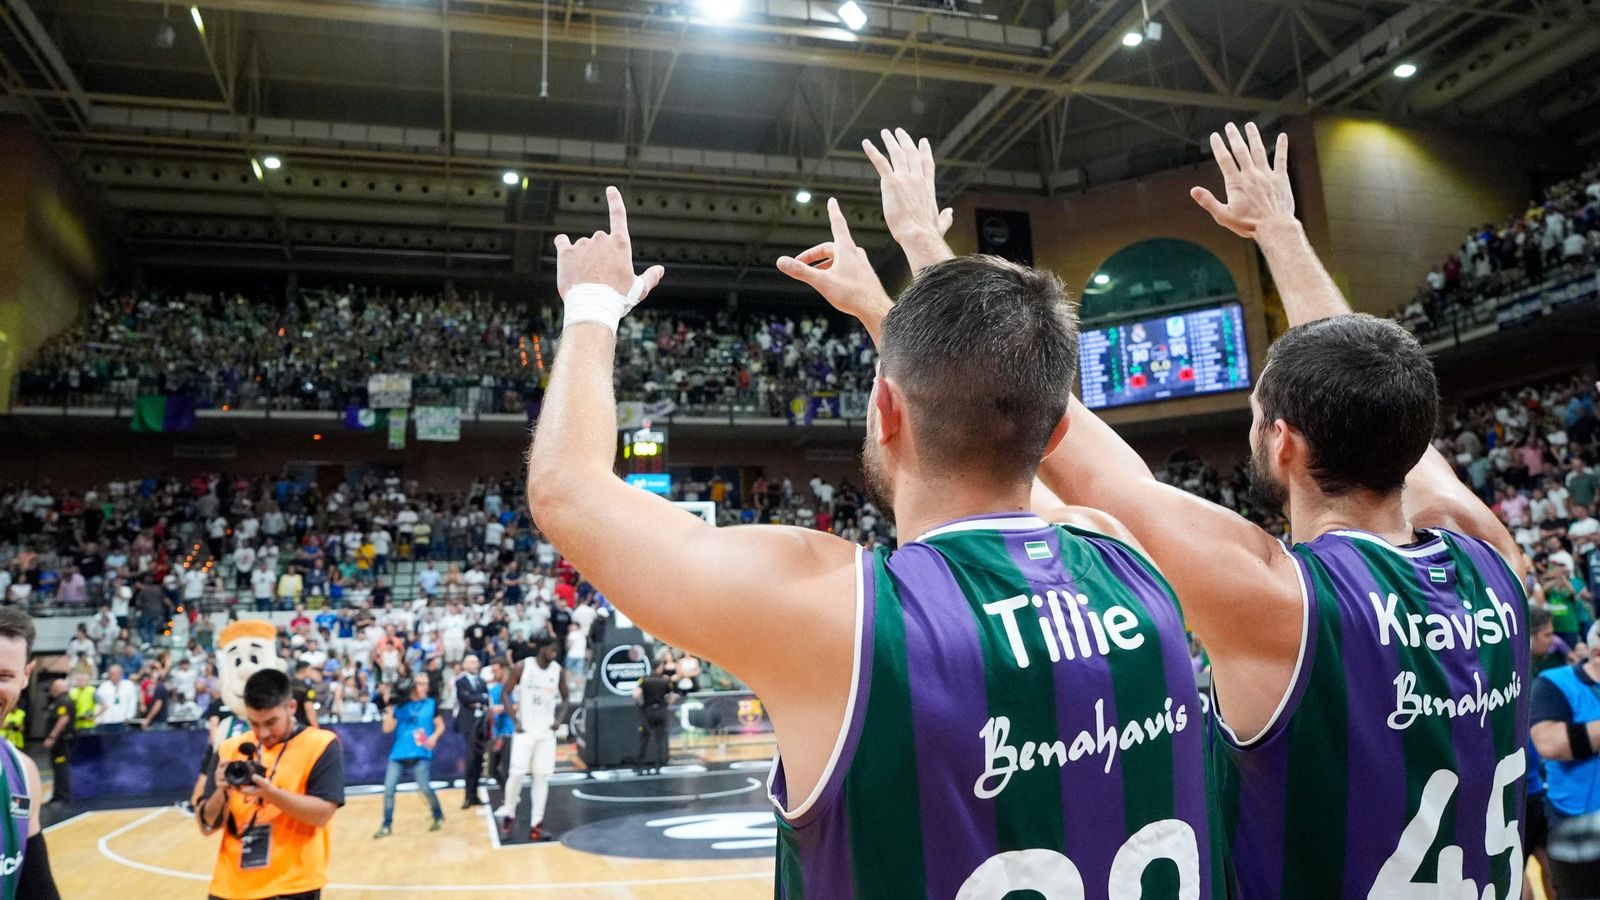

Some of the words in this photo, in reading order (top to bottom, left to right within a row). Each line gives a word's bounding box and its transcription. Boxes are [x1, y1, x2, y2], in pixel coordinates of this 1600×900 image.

[983, 590, 1145, 668] Tillie
[1369, 587, 1518, 650] Kravish
[1367, 747, 1526, 900] 45
